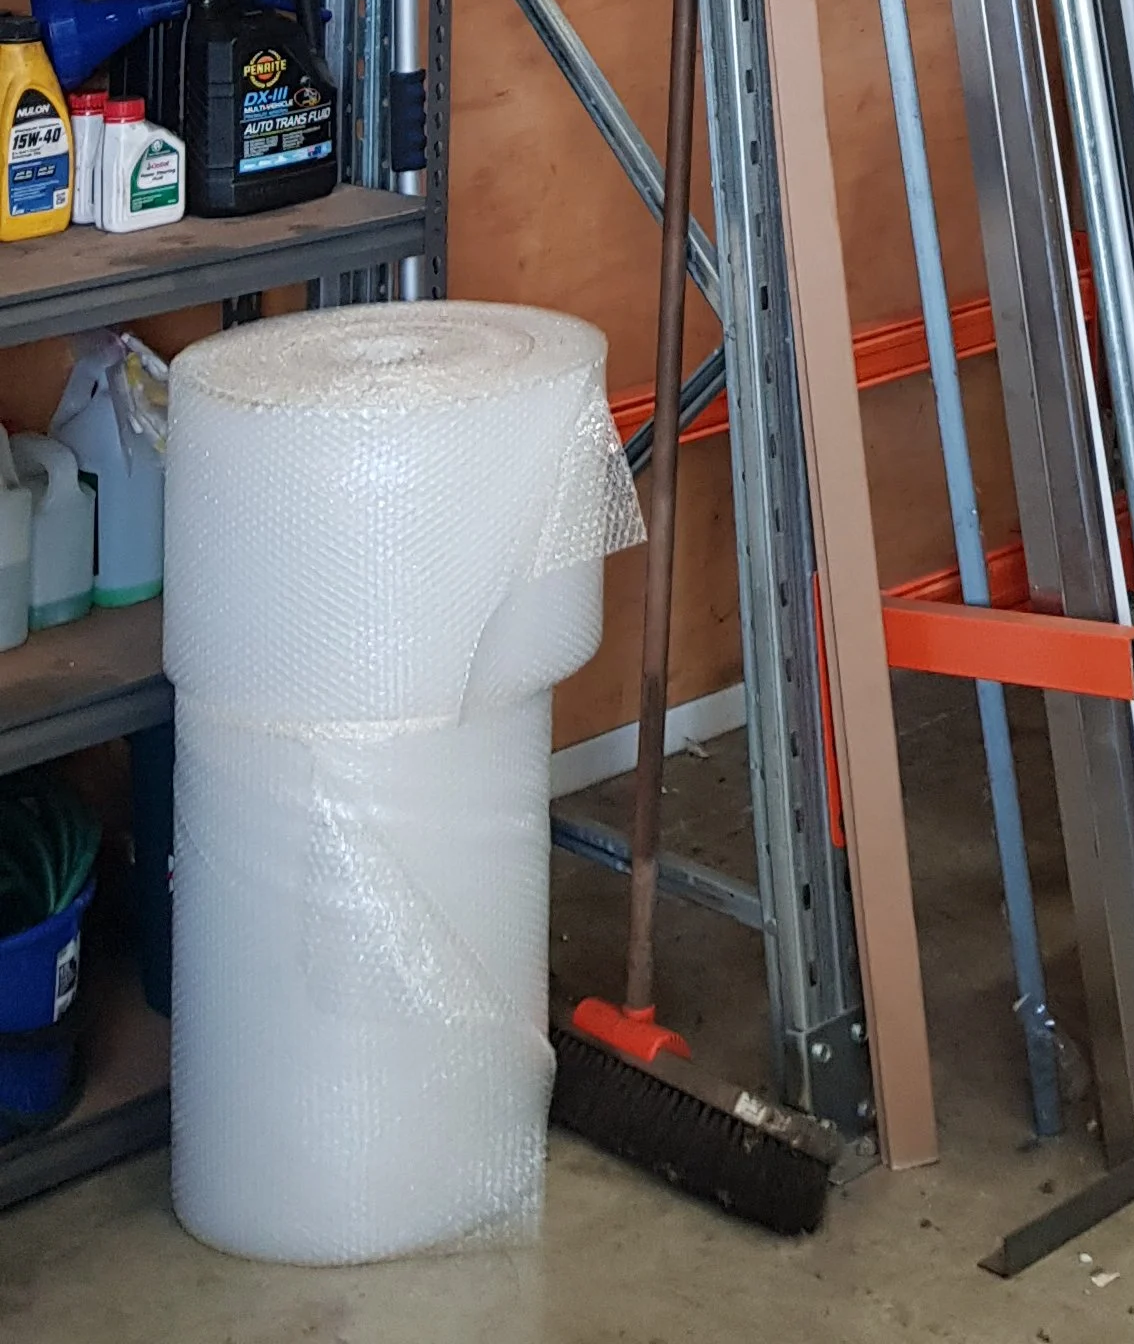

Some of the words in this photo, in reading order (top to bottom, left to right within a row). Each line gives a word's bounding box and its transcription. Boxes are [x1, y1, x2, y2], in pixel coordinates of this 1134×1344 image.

[243, 59, 287, 77] PENRITE
[244, 86, 289, 106] DX-III
[16, 103, 51, 118] NULON
[244, 120, 273, 135] AUTO
[276, 111, 307, 131] TRANS
[307, 107, 331, 123] FLUID
[13, 127, 61, 150] 15W-40
